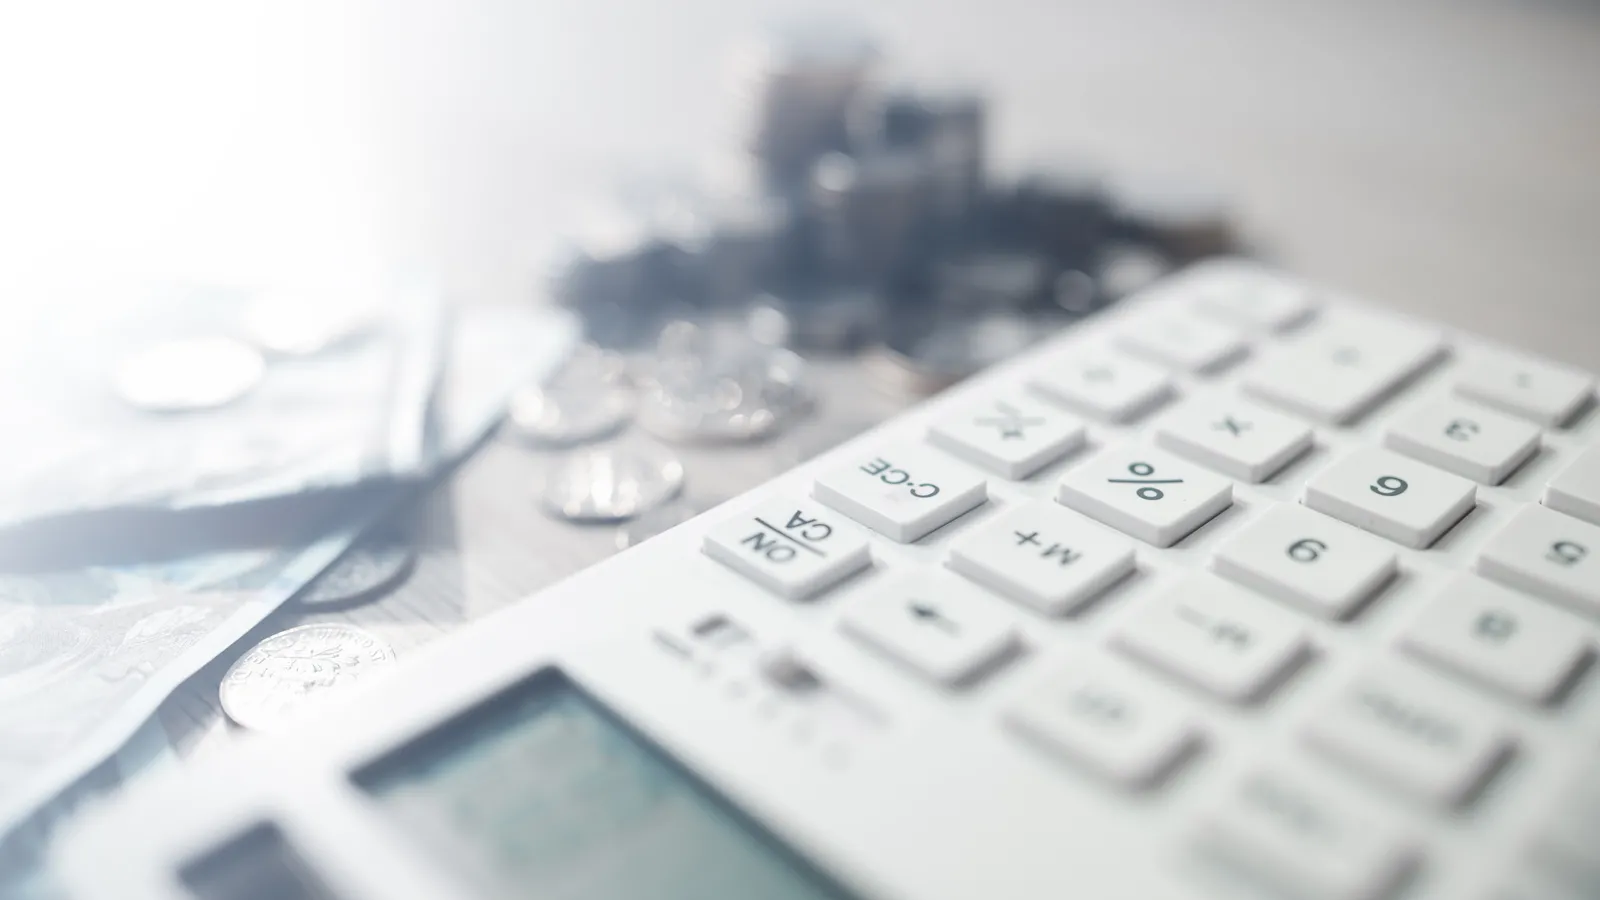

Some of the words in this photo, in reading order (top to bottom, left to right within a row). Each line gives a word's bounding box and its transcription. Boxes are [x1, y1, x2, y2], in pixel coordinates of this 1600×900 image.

[1107, 461, 1184, 501] %
[1369, 475, 1408, 497] 6
[784, 509, 832, 542] CA
[741, 531, 797, 564] ON
[1014, 530, 1083, 567] M+
[1285, 538, 1328, 564] 9
[1546, 540, 1588, 567] 5
